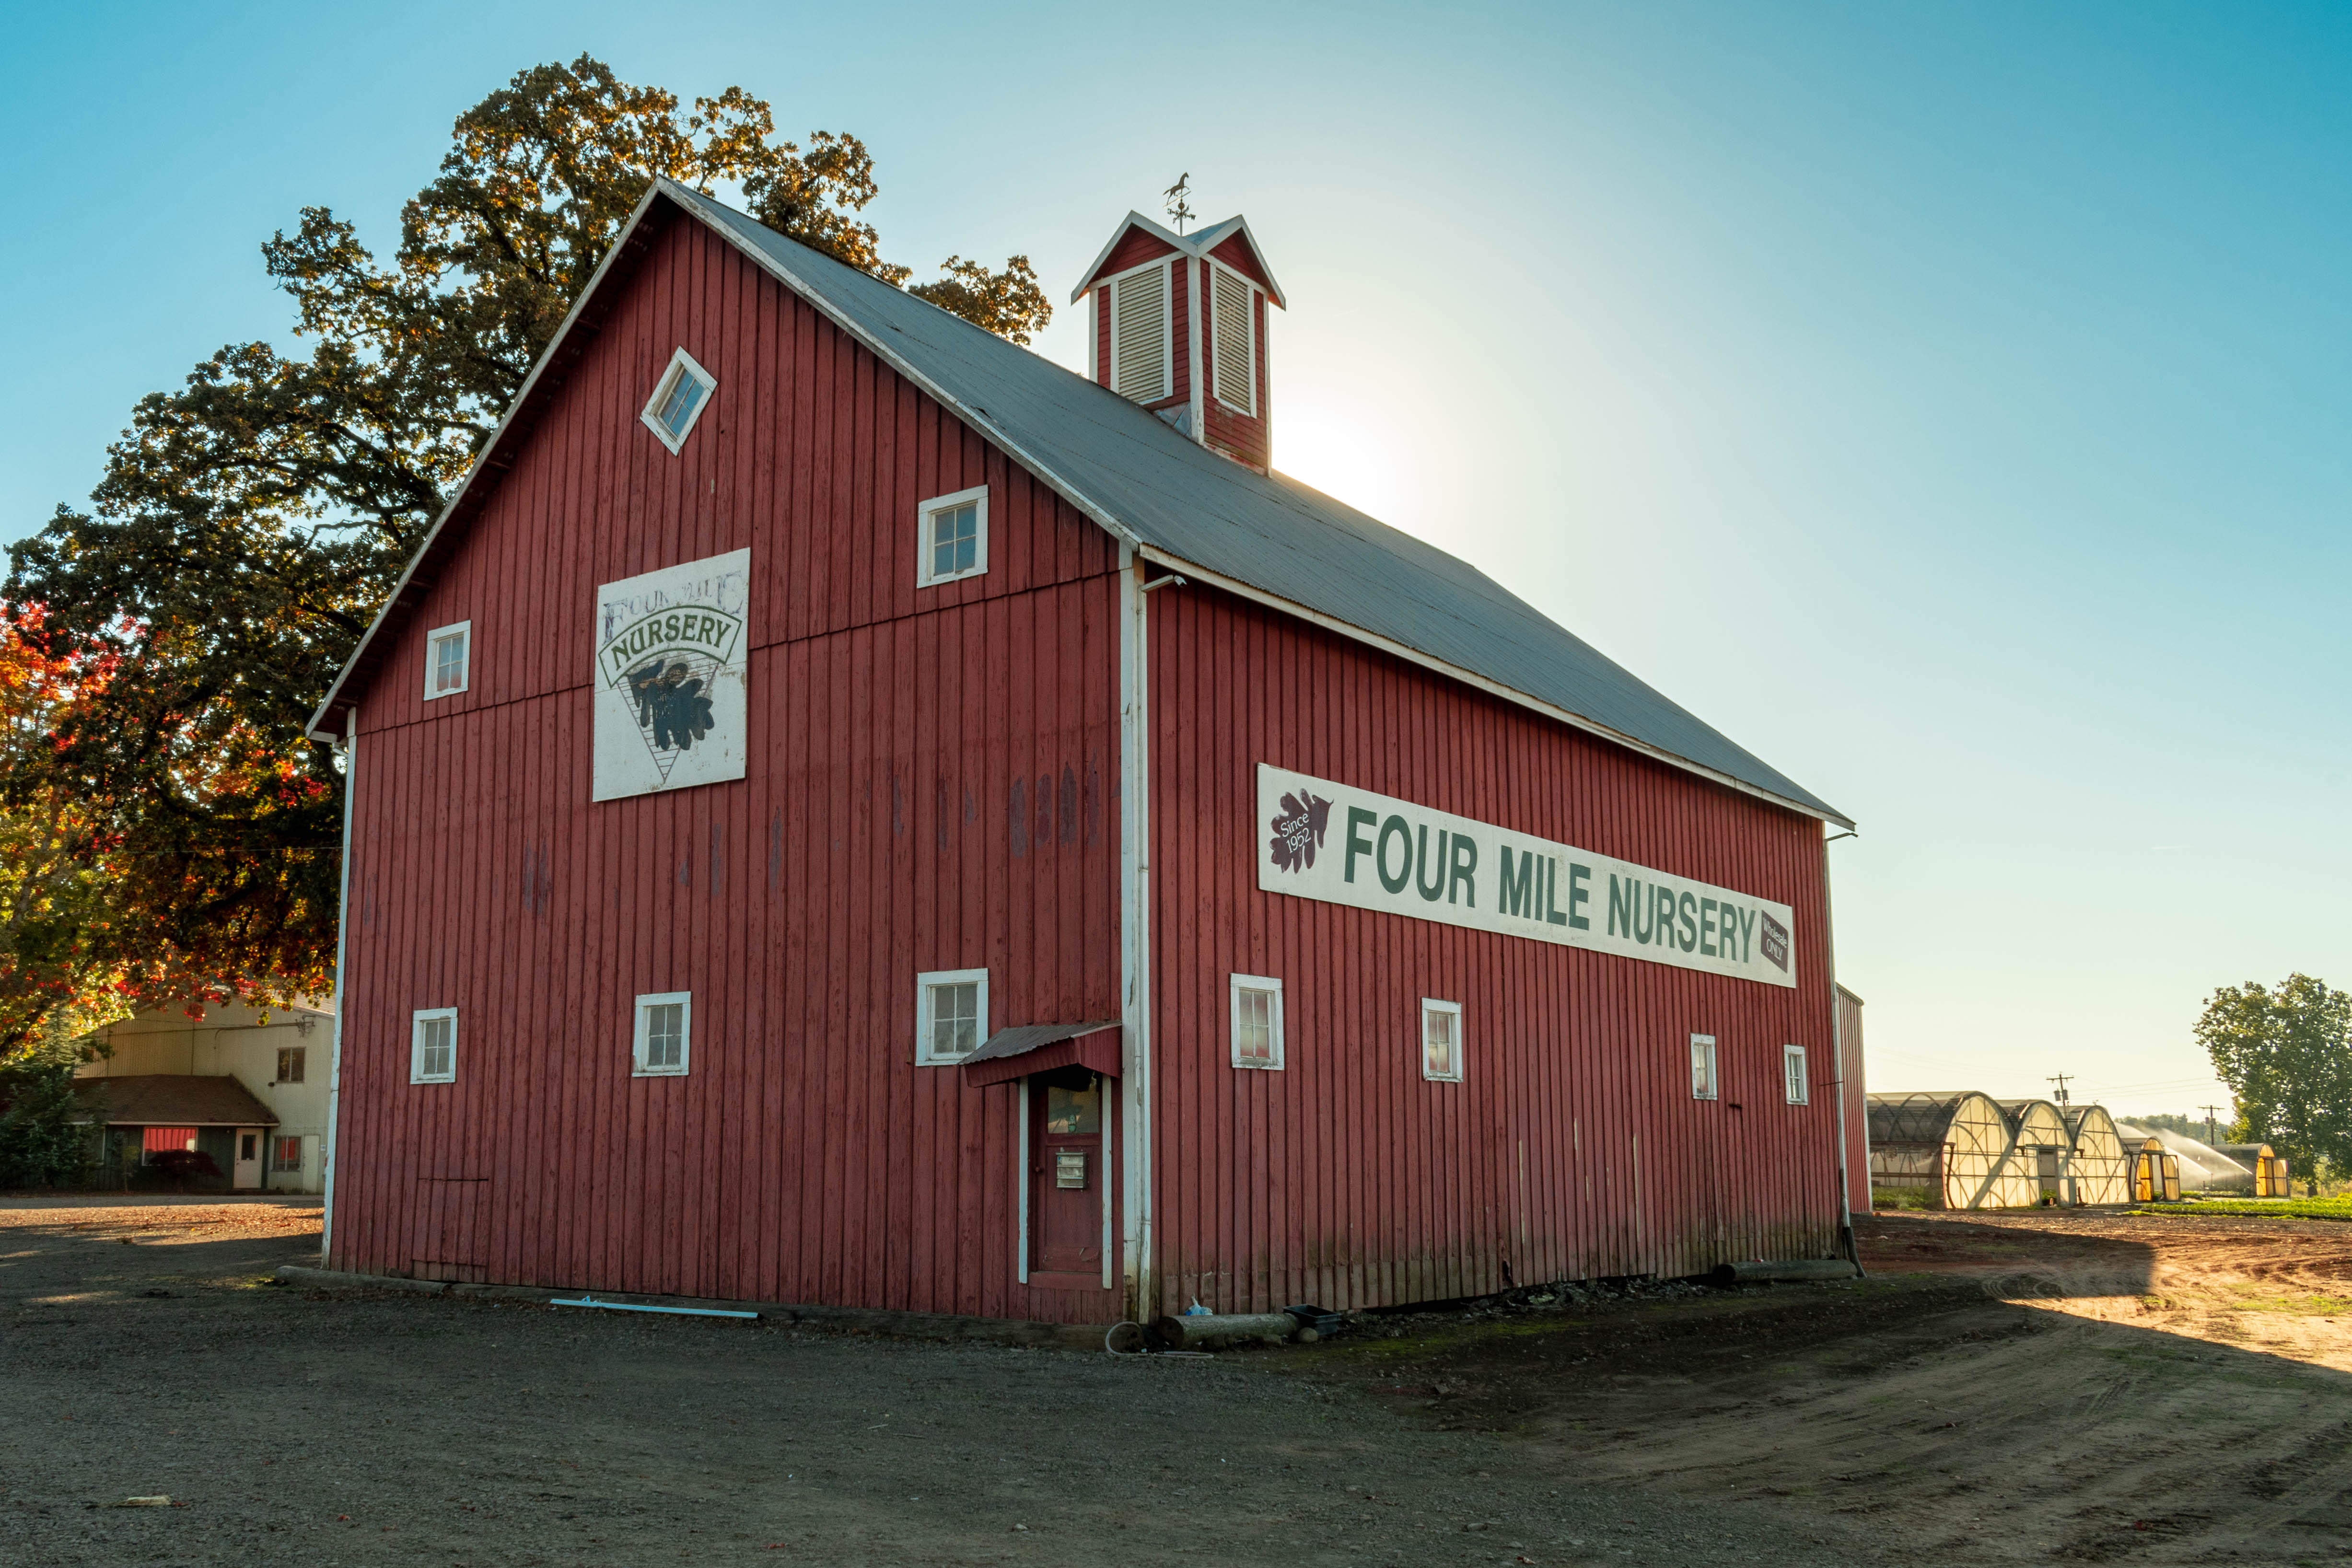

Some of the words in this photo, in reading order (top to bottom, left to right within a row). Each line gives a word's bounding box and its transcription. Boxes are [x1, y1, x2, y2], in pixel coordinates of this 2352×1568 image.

[611, 614, 732, 671] NURSERY
[1281, 813, 1309, 837] Since
[1286, 827, 1311, 853] 1952
[1344, 805, 1478, 908] FOUR
[1499, 845, 1591, 931] MILE
[1608, 873, 1756, 963] NURSERY
[1762, 917, 1787, 948] Wholesale
[1766, 938, 1783, 961] ONLY
